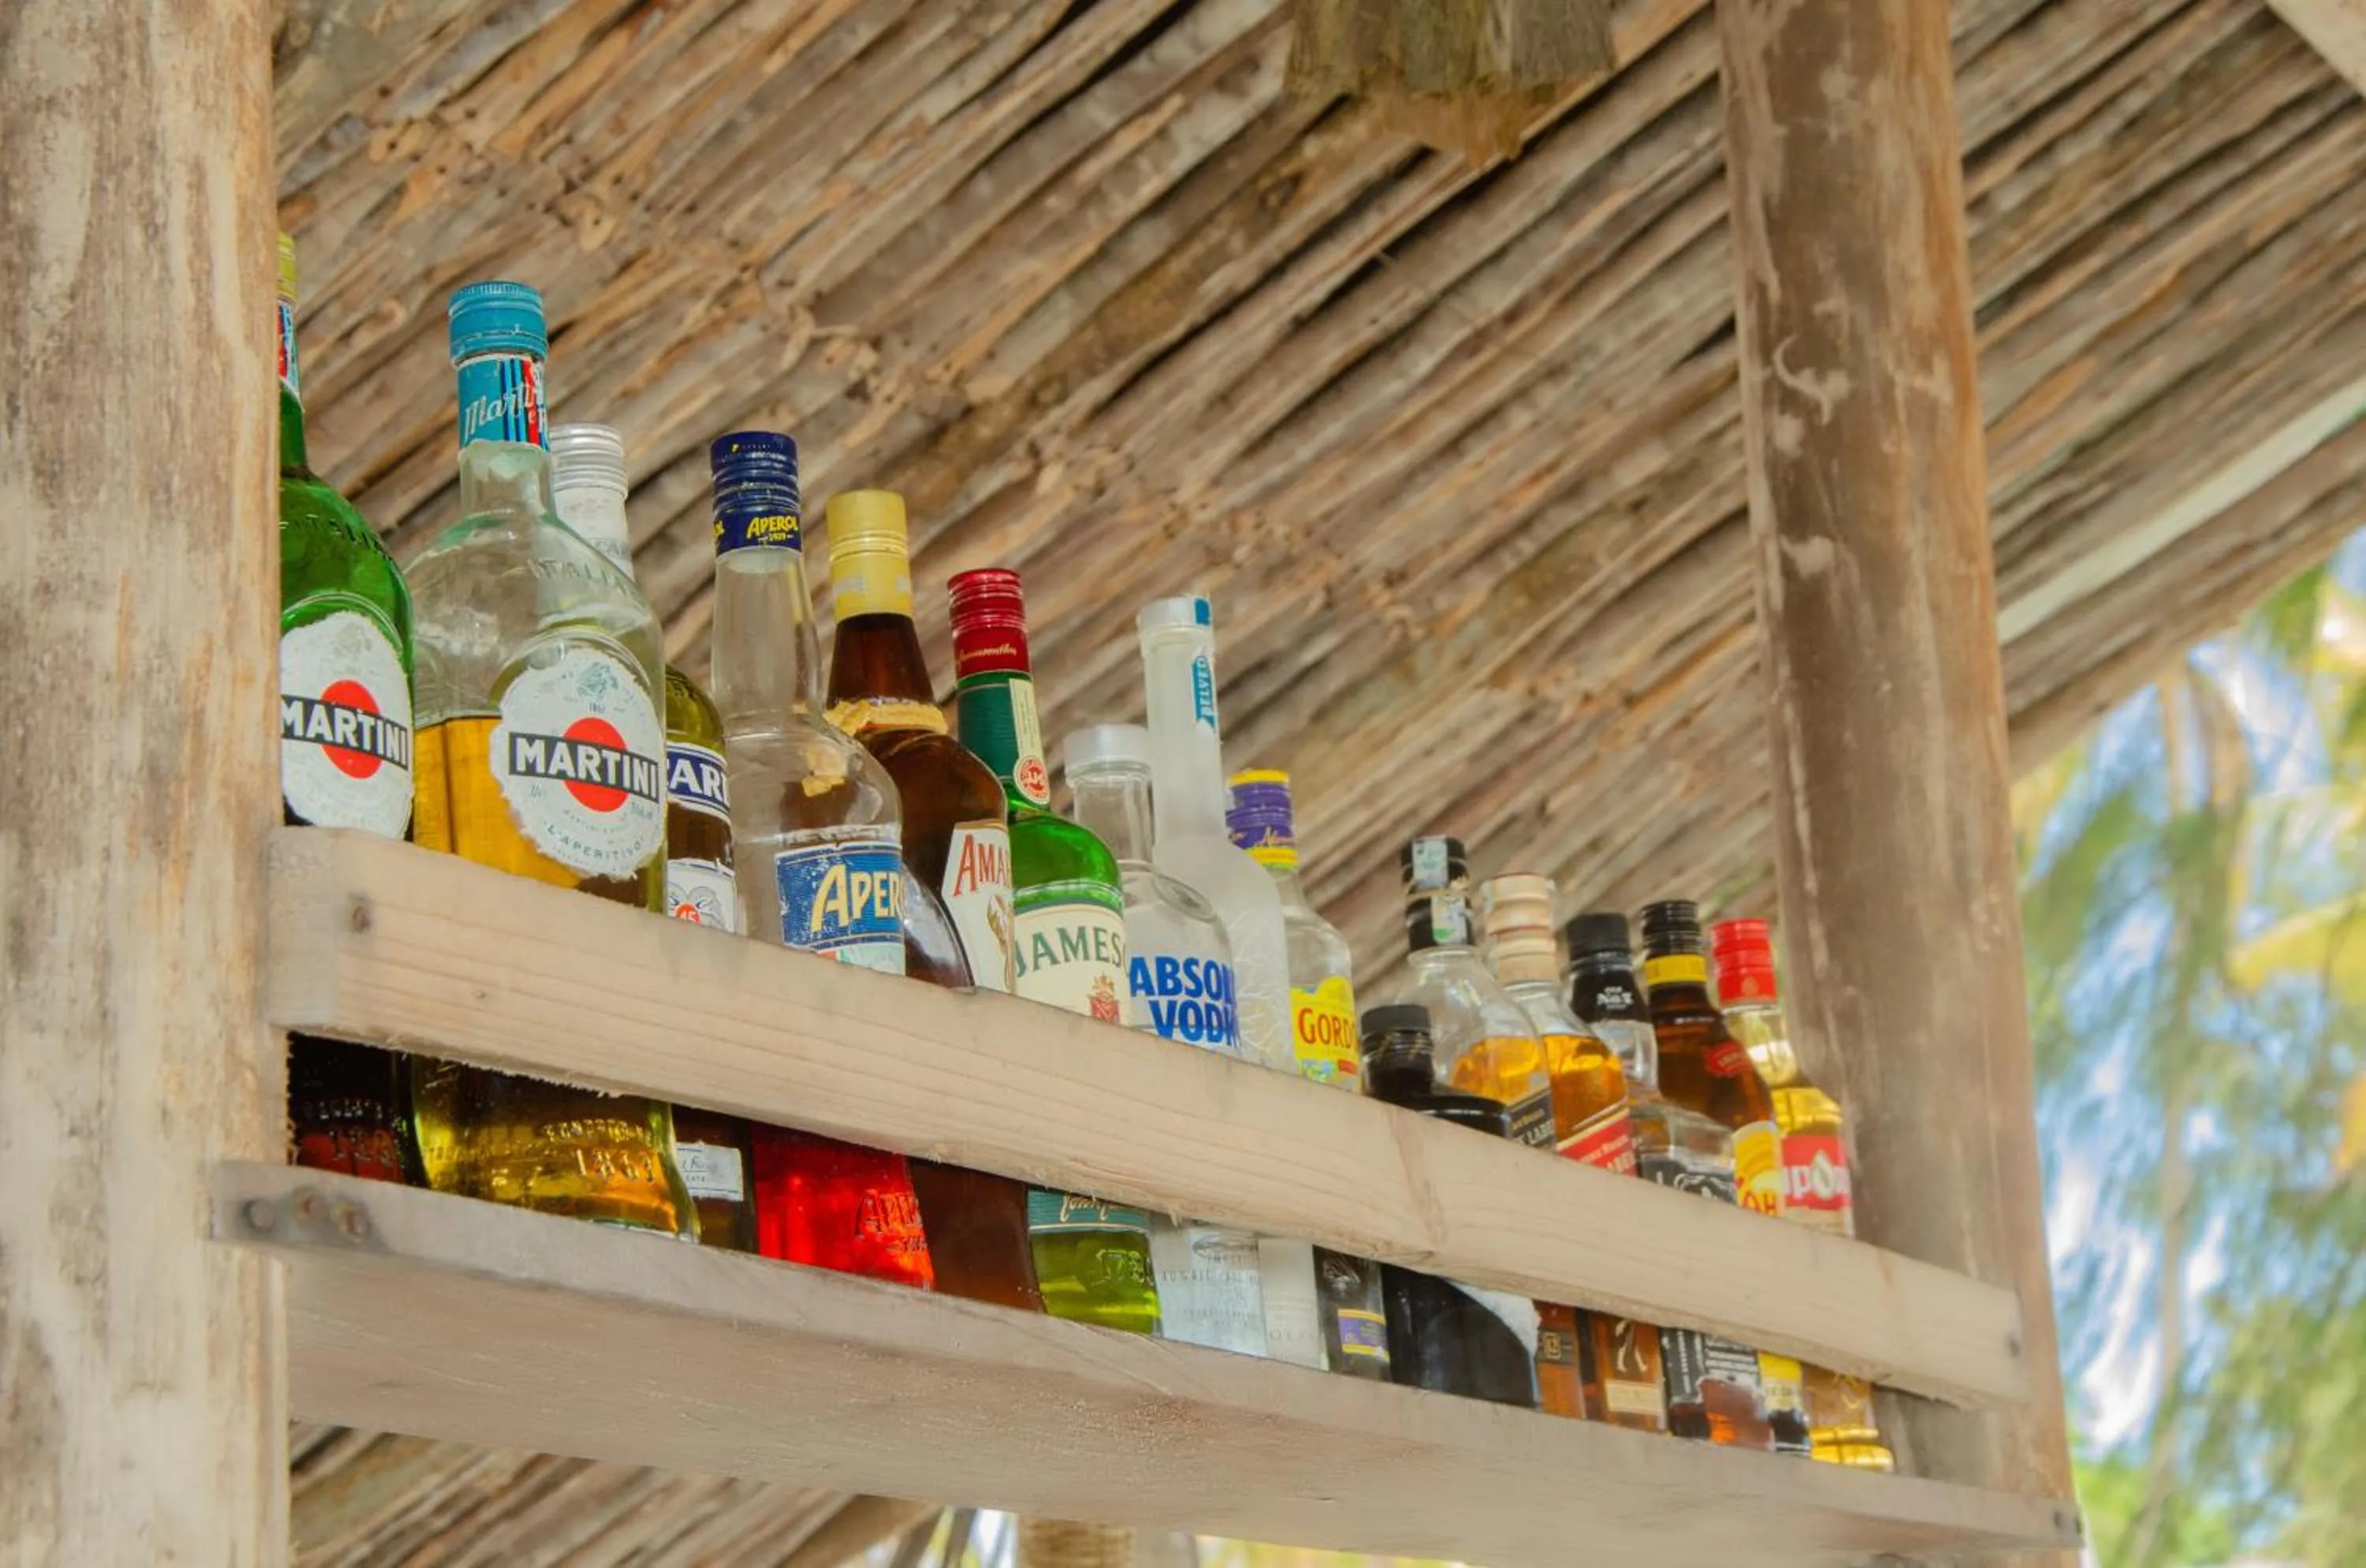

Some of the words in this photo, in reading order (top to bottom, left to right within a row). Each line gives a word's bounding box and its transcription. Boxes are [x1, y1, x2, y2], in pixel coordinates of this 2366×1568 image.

[281, 699, 407, 766] MARTINI
[515, 736, 659, 802] MARTINI
[810, 864, 906, 934] APER
[1015, 925, 1125, 978] JAMES
